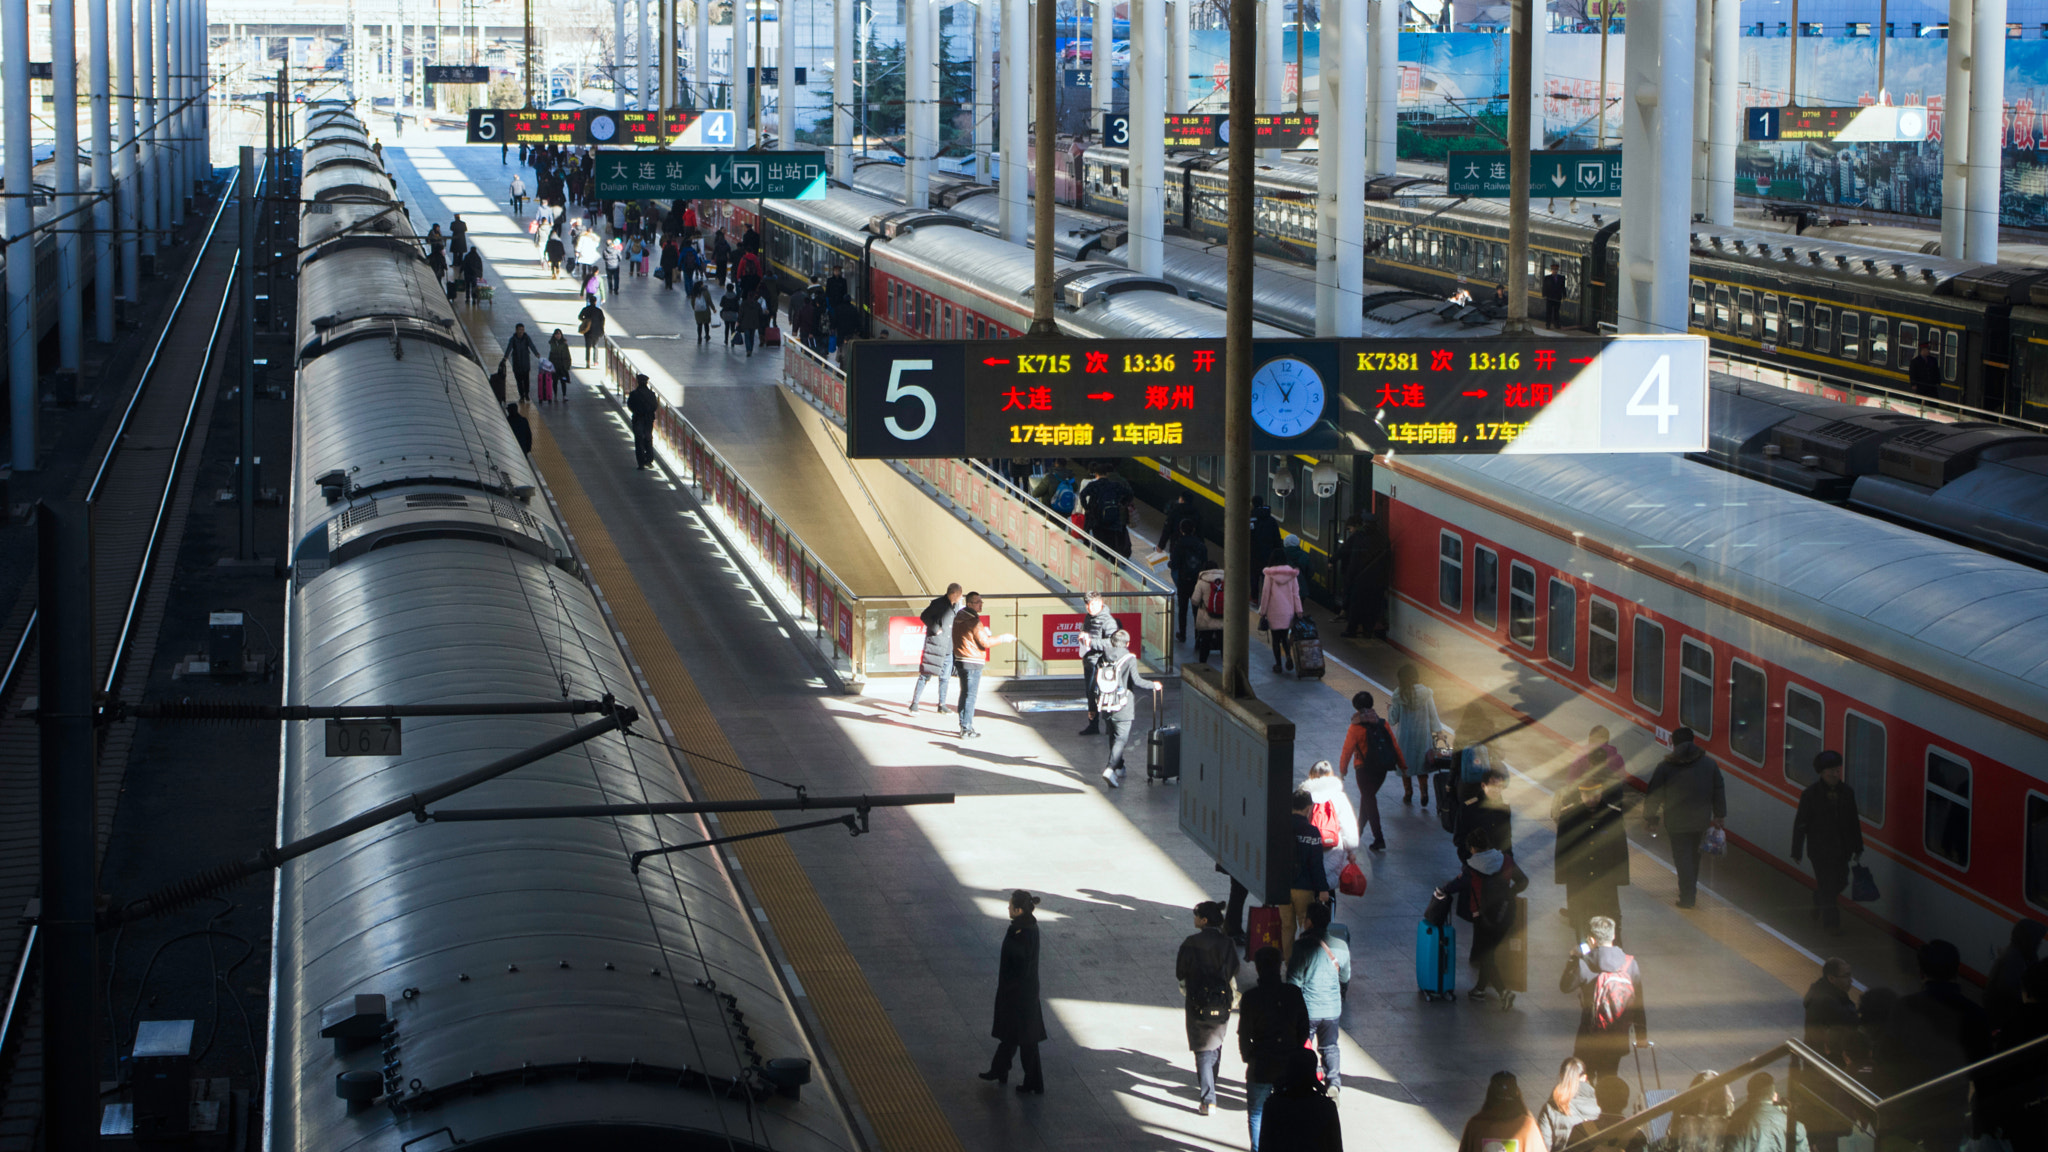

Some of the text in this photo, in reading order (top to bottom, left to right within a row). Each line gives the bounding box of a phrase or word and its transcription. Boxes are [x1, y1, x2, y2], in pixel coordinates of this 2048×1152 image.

[478, 114, 496, 140] 5
[708, 114, 727, 142] 4
[1112, 118, 1129, 144] 3
[1760, 111, 1769, 137] 1
[611, 161, 683, 179] 大连站
[768, 163, 818, 181] 出站口
[601, 183, 699, 193] Dalian Railway Station
[768, 184, 784, 193] Exit
[1454, 182, 1480, 191] Dalian
[1484, 182, 1510, 191] Railwa
[1017, 350, 1216, 374] K715 次 13:36 开
[1281, 362, 1292, 372] 12
[1356, 349, 1557, 372] K7381 次 13:16 开
[883, 359, 937, 440] 5
[1001, 385, 1194, 412] 大连 郑州
[1312, 393, 1320, 403] 3
[1375, 383, 1426, 409] 大连
[1626, 355, 1680, 434] 4
[1010, 421, 1183, 446] 17车向前，1车向后
[1281, 424, 1289, 433] 6
[338, 728, 393, 753] 067
